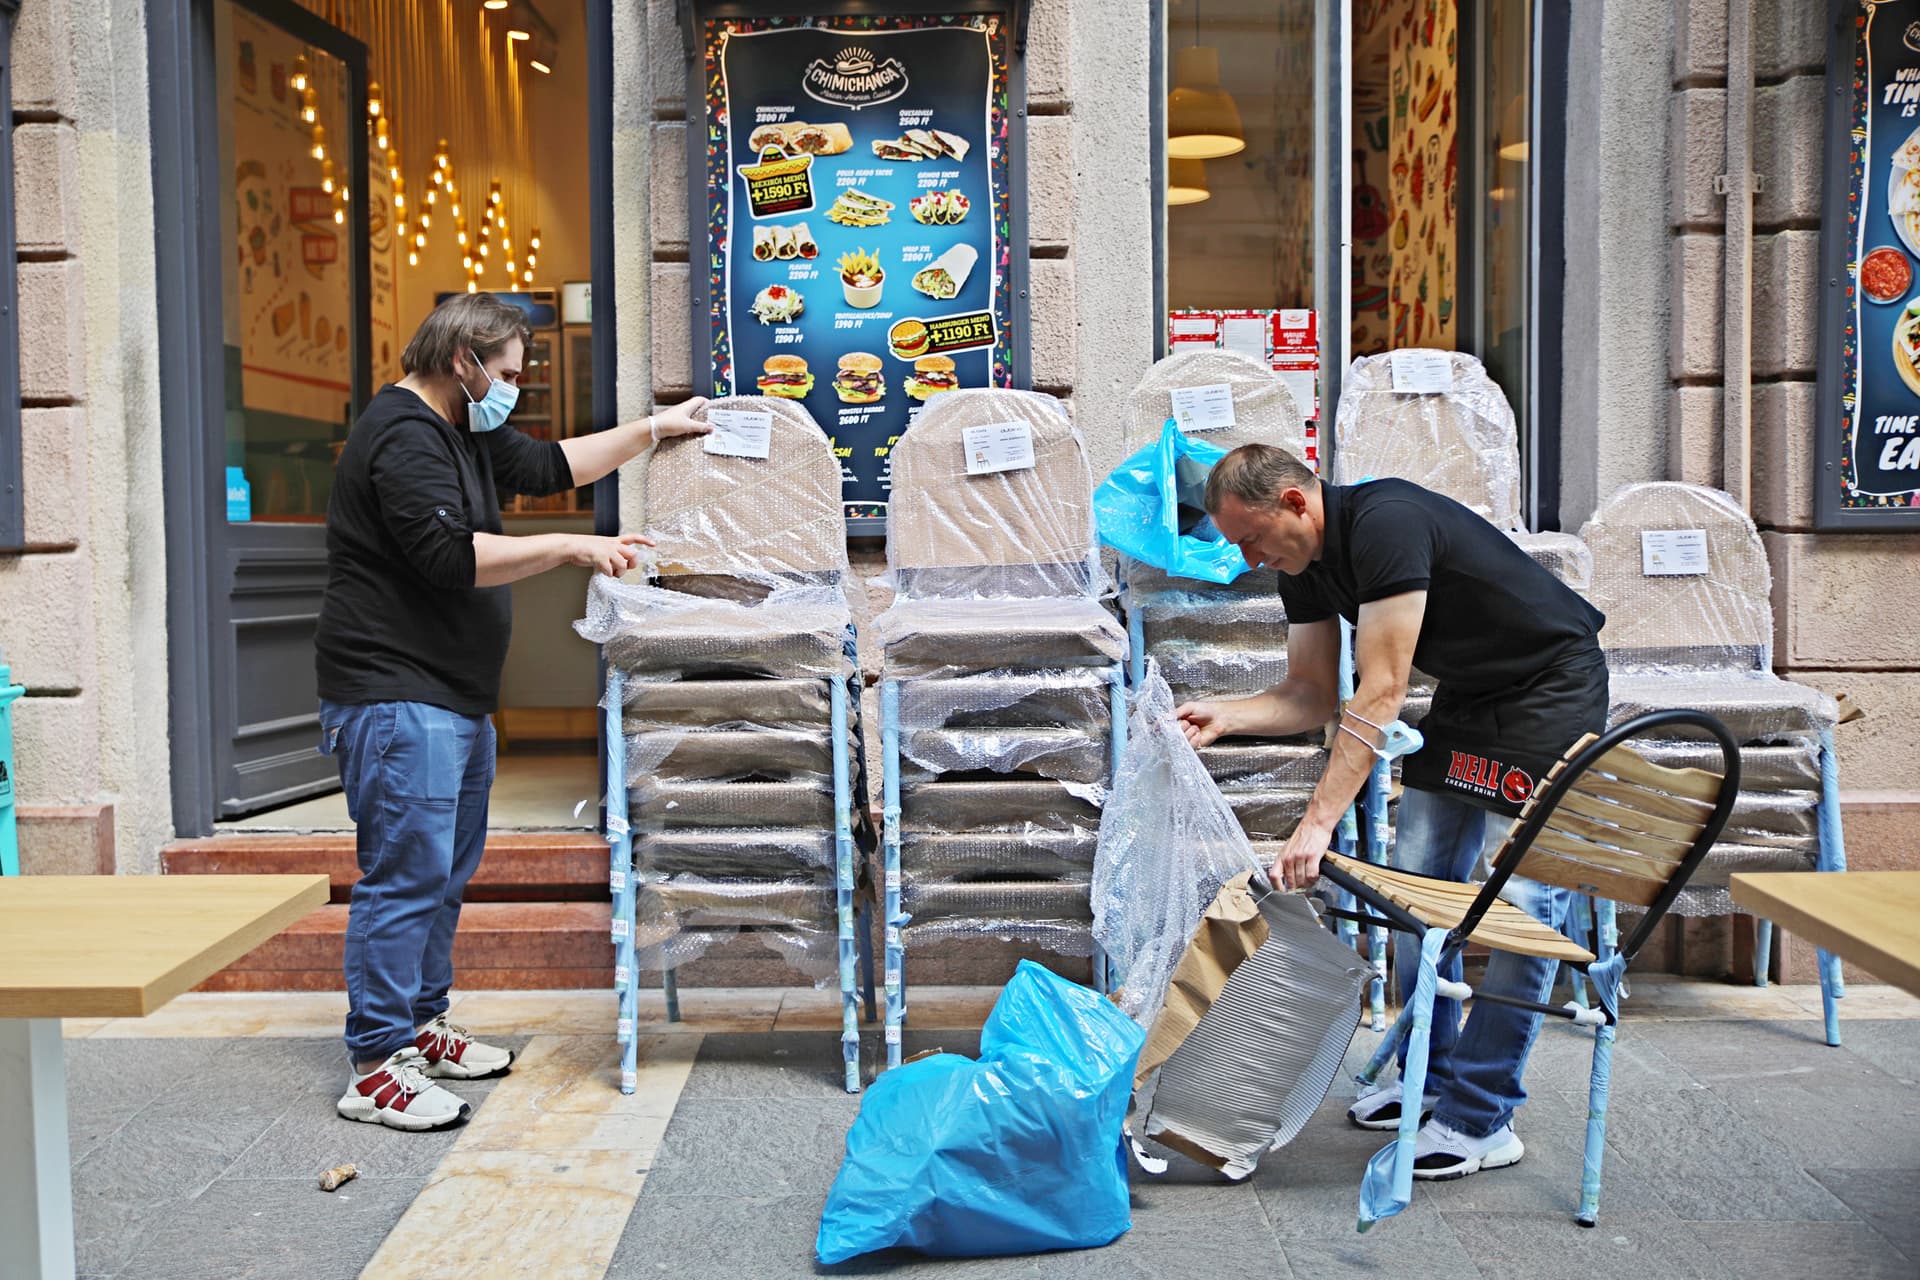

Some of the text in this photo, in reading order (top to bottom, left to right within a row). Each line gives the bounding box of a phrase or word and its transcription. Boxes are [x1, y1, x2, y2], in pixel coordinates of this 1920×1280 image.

[811, 67, 900, 92] CHIMICHANGA
[1896, 68, 1920, 81] WHA
[1883, 83, 1920, 105] TIM
[1901, 103, 1918, 117] IS
[752, 184, 793, 202] +1590
[794, 182, 809, 194] Ft
[929, 318, 970, 330] HAMBURGER
[931, 325, 972, 343] +1190
[973, 323, 989, 336] Ft
[839, 415, 859, 425] 2600
[1874, 415, 1919, 434] TIME
[1878, 436, 1920, 470] EA
[1447, 750, 1500, 790] HELL
[1444, 777, 1497, 798] ENERGY DRINK
